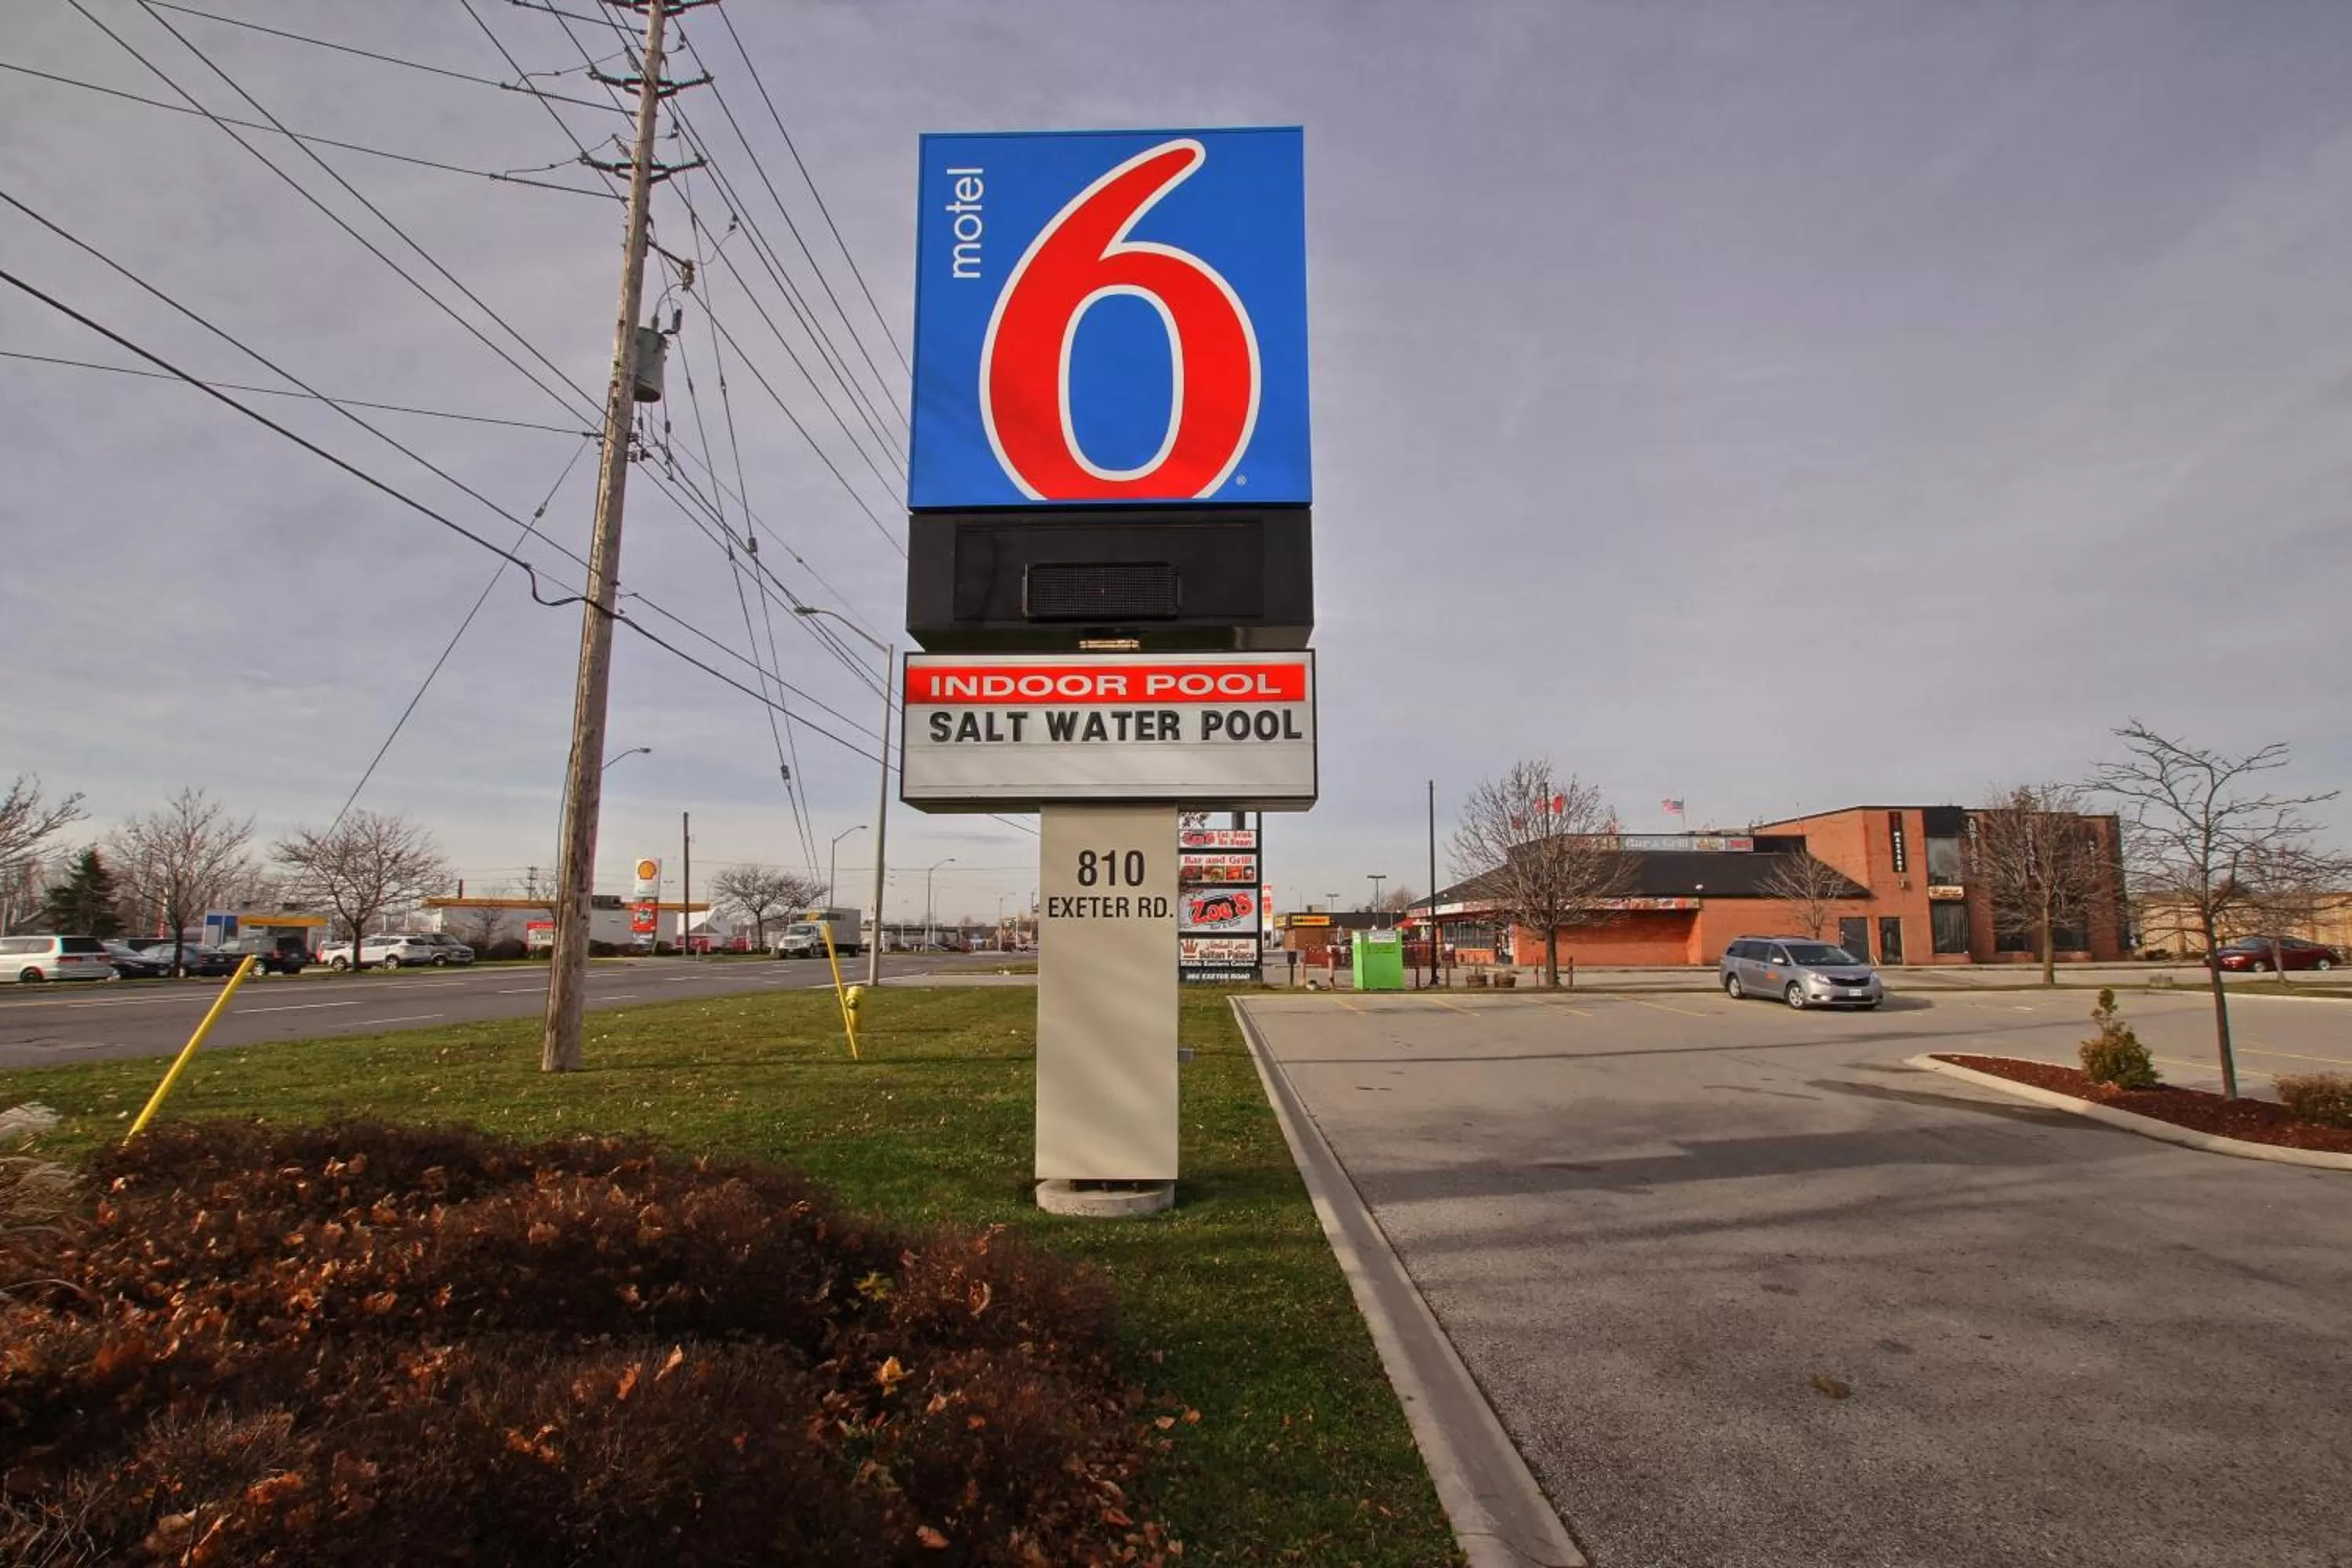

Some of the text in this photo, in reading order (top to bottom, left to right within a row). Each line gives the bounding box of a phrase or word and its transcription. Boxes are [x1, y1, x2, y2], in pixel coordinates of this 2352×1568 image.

[946, 167, 984, 278] motel
[978, 138, 1261, 501] 6
[930, 673, 1283, 697] INDOOR POOL
[929, 710, 1302, 742] SALT WATER POOL
[1077, 850, 1145, 887] 810
[1048, 897, 1174, 918] EXETER RD.
[1199, 949, 1255, 958] Sultan Palace
